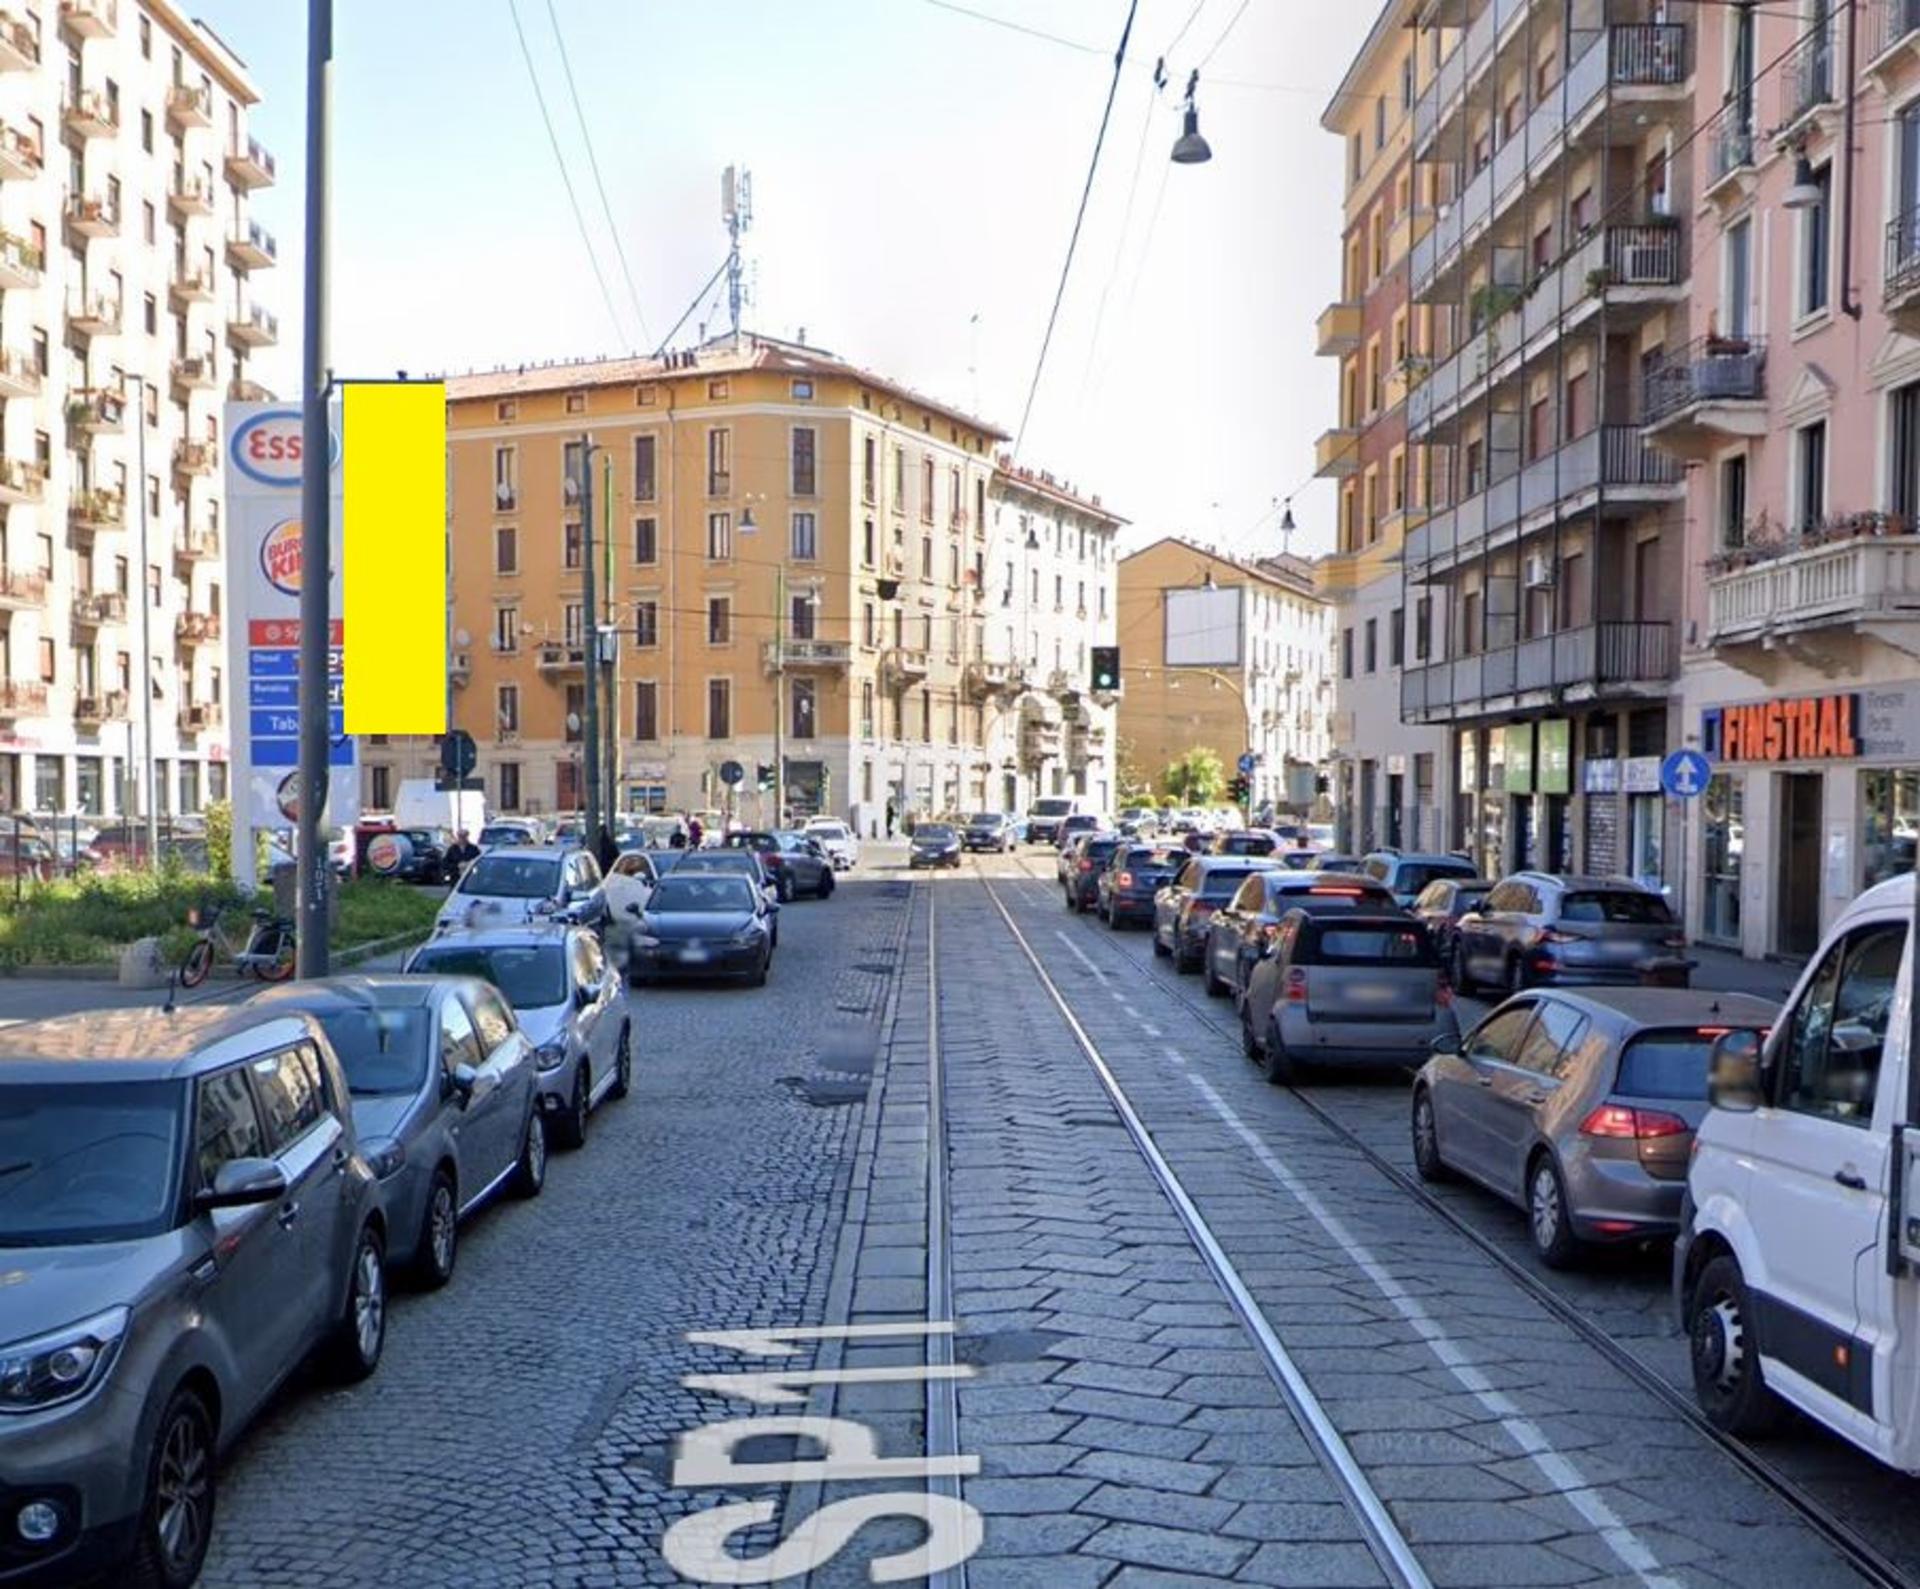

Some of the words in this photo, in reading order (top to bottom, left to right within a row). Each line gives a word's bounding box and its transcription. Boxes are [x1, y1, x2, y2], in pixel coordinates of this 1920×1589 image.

[249, 429, 303, 460] Ess
[268, 537, 303, 562] BUR
[1723, 694, 1856, 762] FINSTRAL
